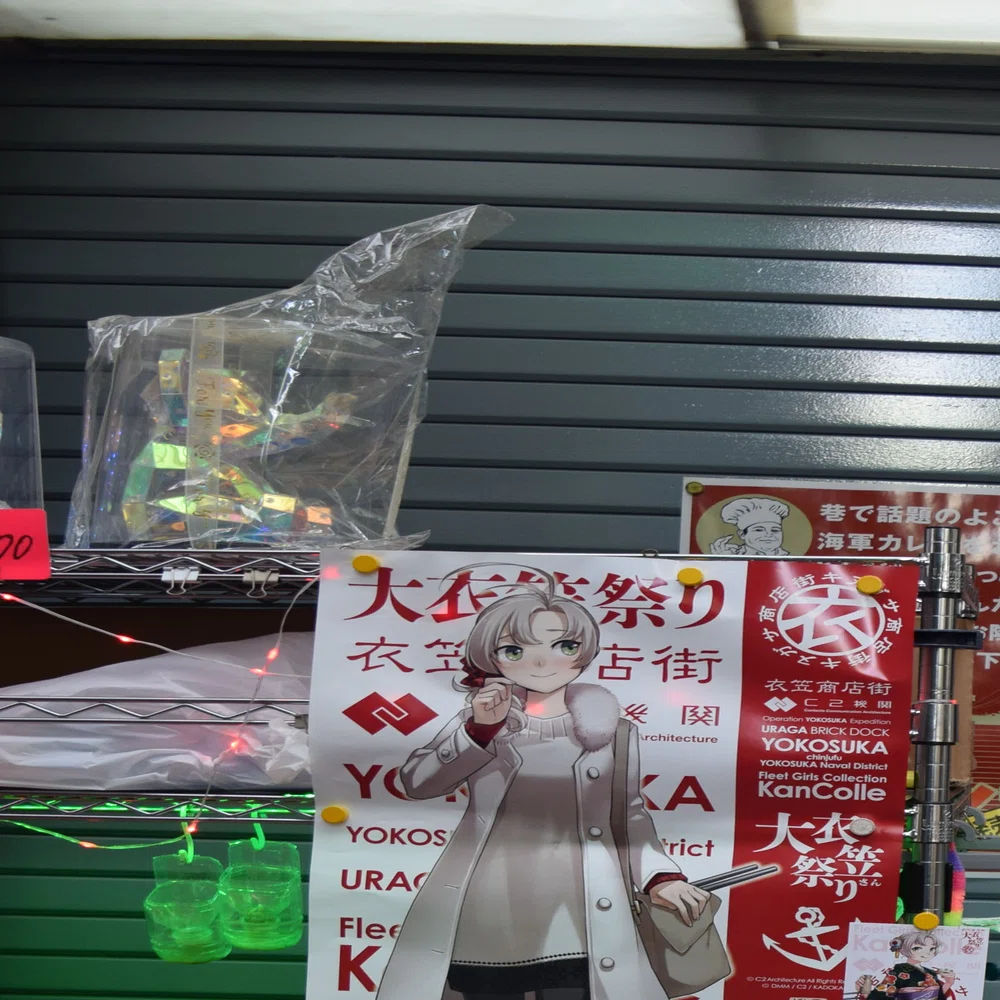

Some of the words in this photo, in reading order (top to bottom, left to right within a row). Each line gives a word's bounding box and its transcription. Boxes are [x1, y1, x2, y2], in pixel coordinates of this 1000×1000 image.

[764, 678, 893, 697] 衣笠商店街
[762, 715, 804, 724] Operation
[805, 716, 847, 724] YOKOSUKA
[850, 717, 892, 726] Expedition
[761, 724, 808, 734] URAGA
[810, 726, 847, 736] BRICK
[849, 727, 890, 737] DOCK
[761, 737, 889, 755] YOKOSUKA
[760, 758, 818, 768] YOKOSUKA
[819, 761, 851, 770] Naval
[852, 762, 888, 771] District
[758, 771, 789, 781] Fleet
[791, 773, 820, 783] Girls
[822, 774, 888, 784] Collection
[757, 780, 887, 801] KanColle
